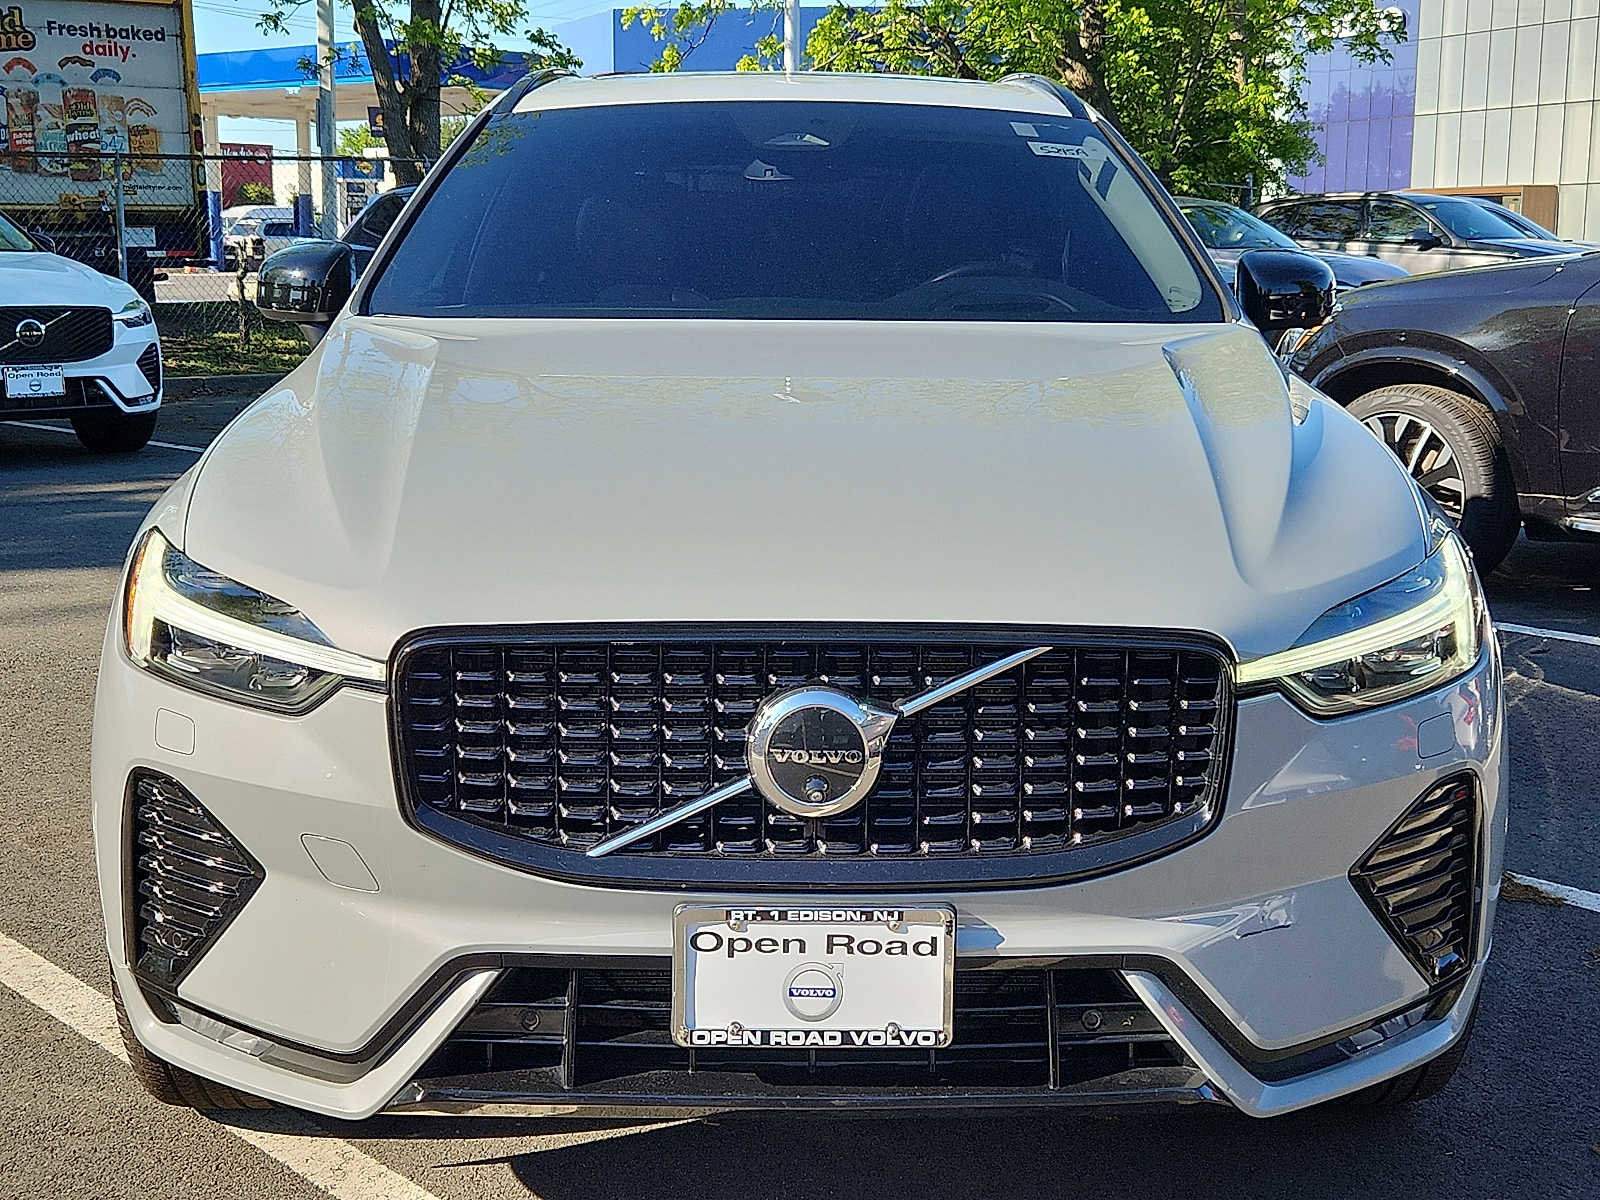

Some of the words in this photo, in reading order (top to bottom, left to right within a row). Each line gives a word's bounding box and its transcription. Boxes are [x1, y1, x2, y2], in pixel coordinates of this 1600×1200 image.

[46, 20, 101, 38] Fresh
[104, 23, 166, 42] baked
[82, 40, 137, 62] daily.
[8, 372, 34, 380] Open
[769, 748, 863, 764] VOLVO
[731, 910, 762, 921] RT.
[769, 911, 779, 921] 1
[787, 911, 866, 923] EDISON,
[873, 911, 899, 922] NJ
[690, 931, 806, 958] Open
[826, 934, 938, 957] Road
[790, 987, 835, 998] VOLVO
[692, 1030, 762, 1046] OPEN
[769, 1031, 842, 1046] ROAD
[849, 1031, 938, 1047] VOLVO
